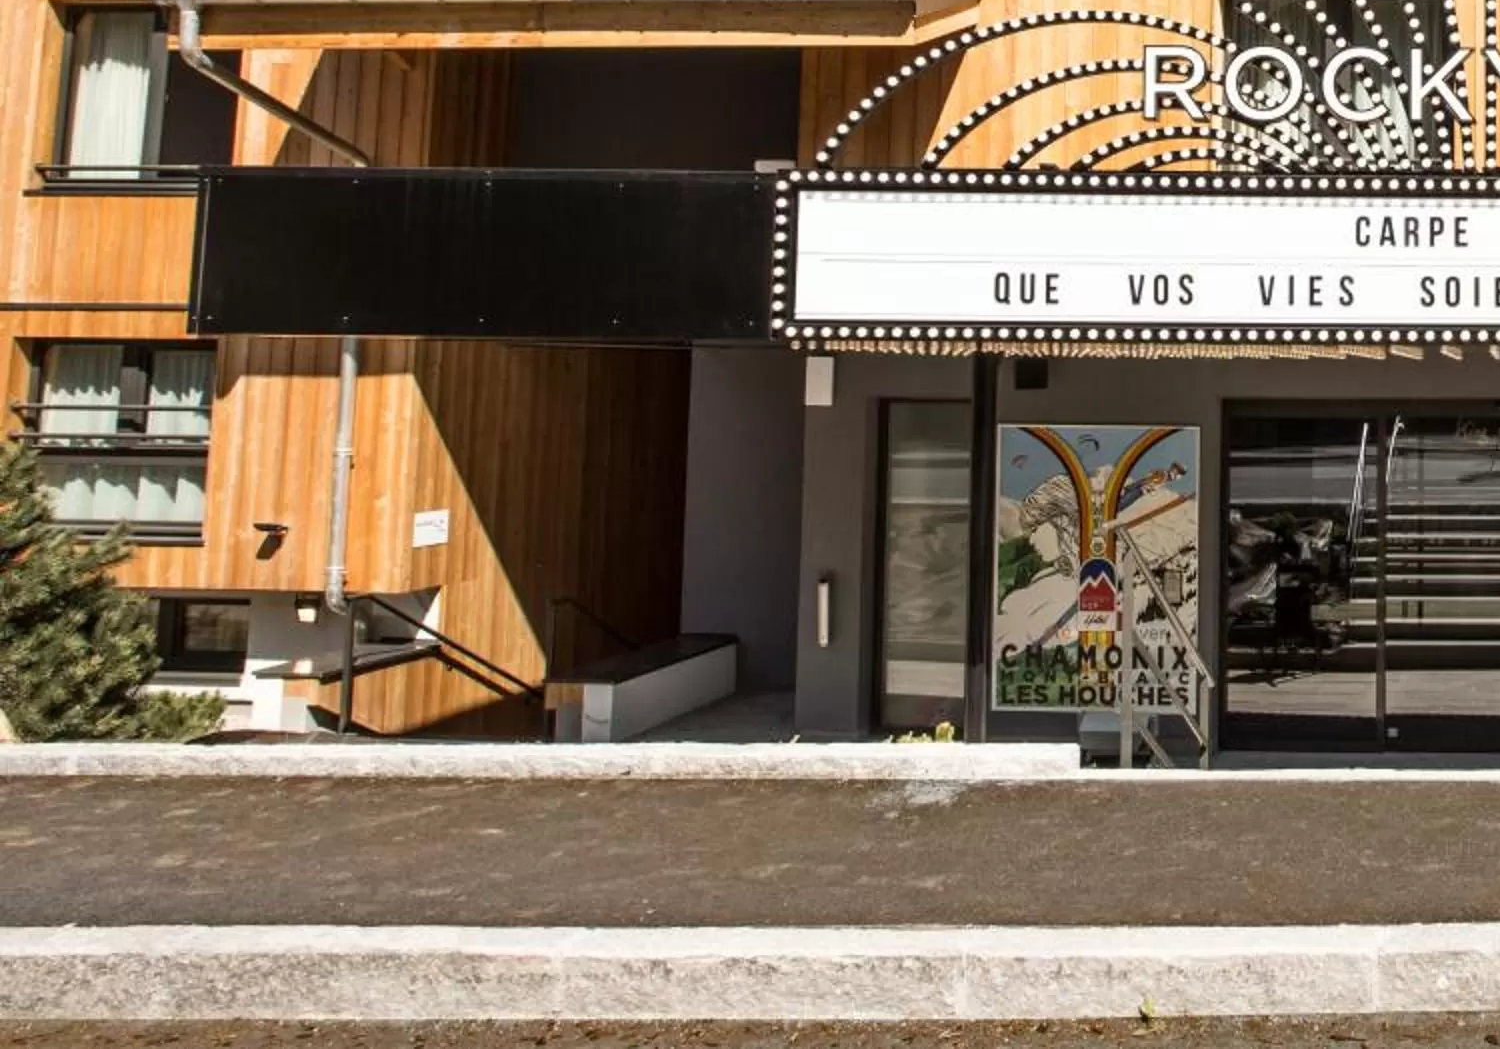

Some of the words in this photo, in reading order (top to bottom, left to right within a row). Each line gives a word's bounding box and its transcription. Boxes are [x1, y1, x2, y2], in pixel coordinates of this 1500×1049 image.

[1355, 215, 1469, 248] CARPE
[994, 272, 1060, 305] QUE
[1128, 273, 1194, 306] VOS
[1258, 274, 1354, 307] VIES
[1000, 643, 1188, 671] CHAMONIX
[1001, 685, 1049, 704] LES
